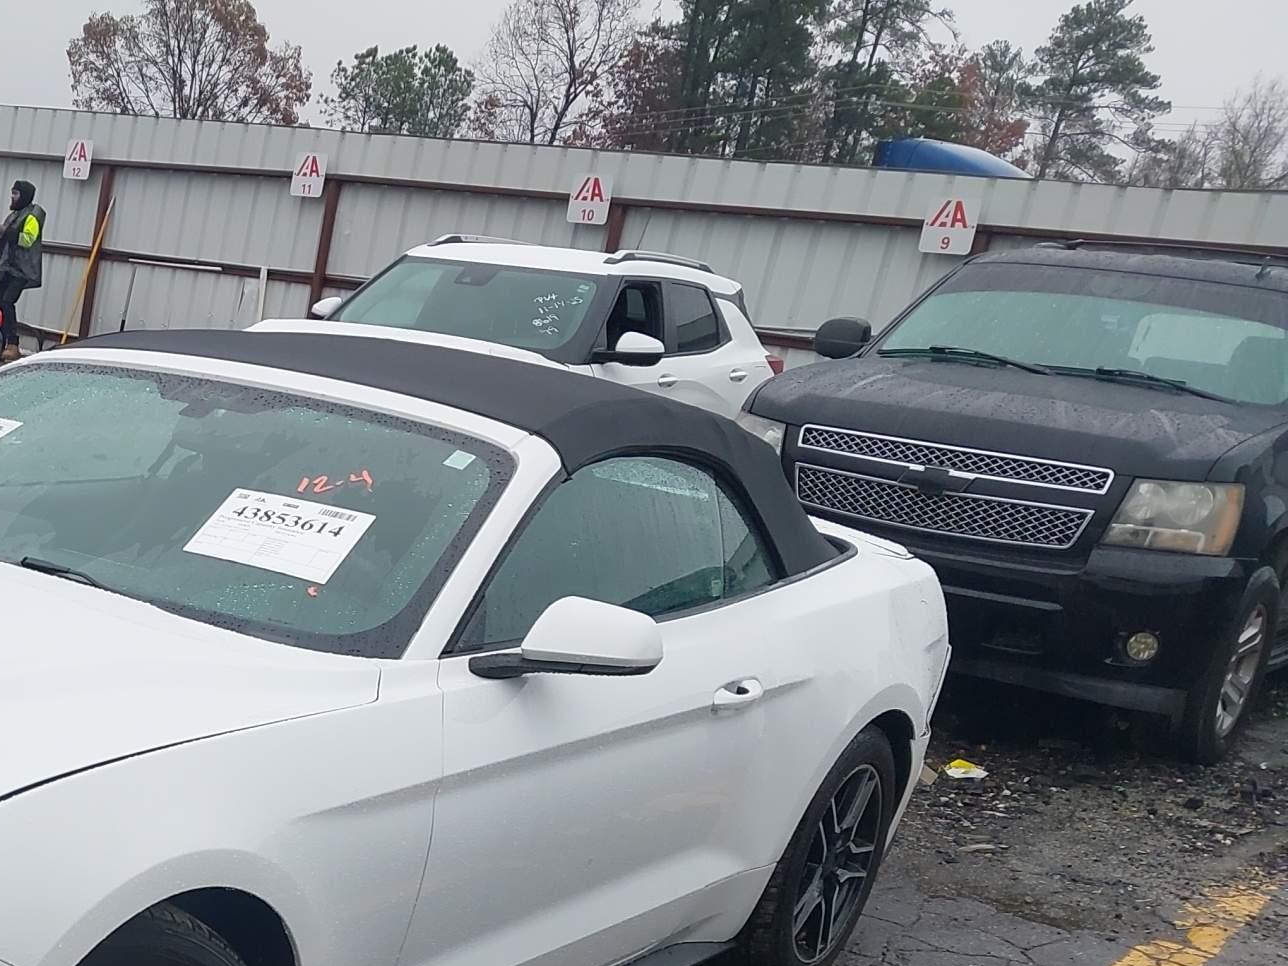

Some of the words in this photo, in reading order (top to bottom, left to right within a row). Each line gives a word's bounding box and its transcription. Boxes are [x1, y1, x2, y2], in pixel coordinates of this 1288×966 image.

[72, 167, 81, 177] 12
[302, 183, 312, 195] 11
[581, 208, 594, 222] 10
[940, 236, 951, 250] 9
[232, 505, 346, 538] 43853614
